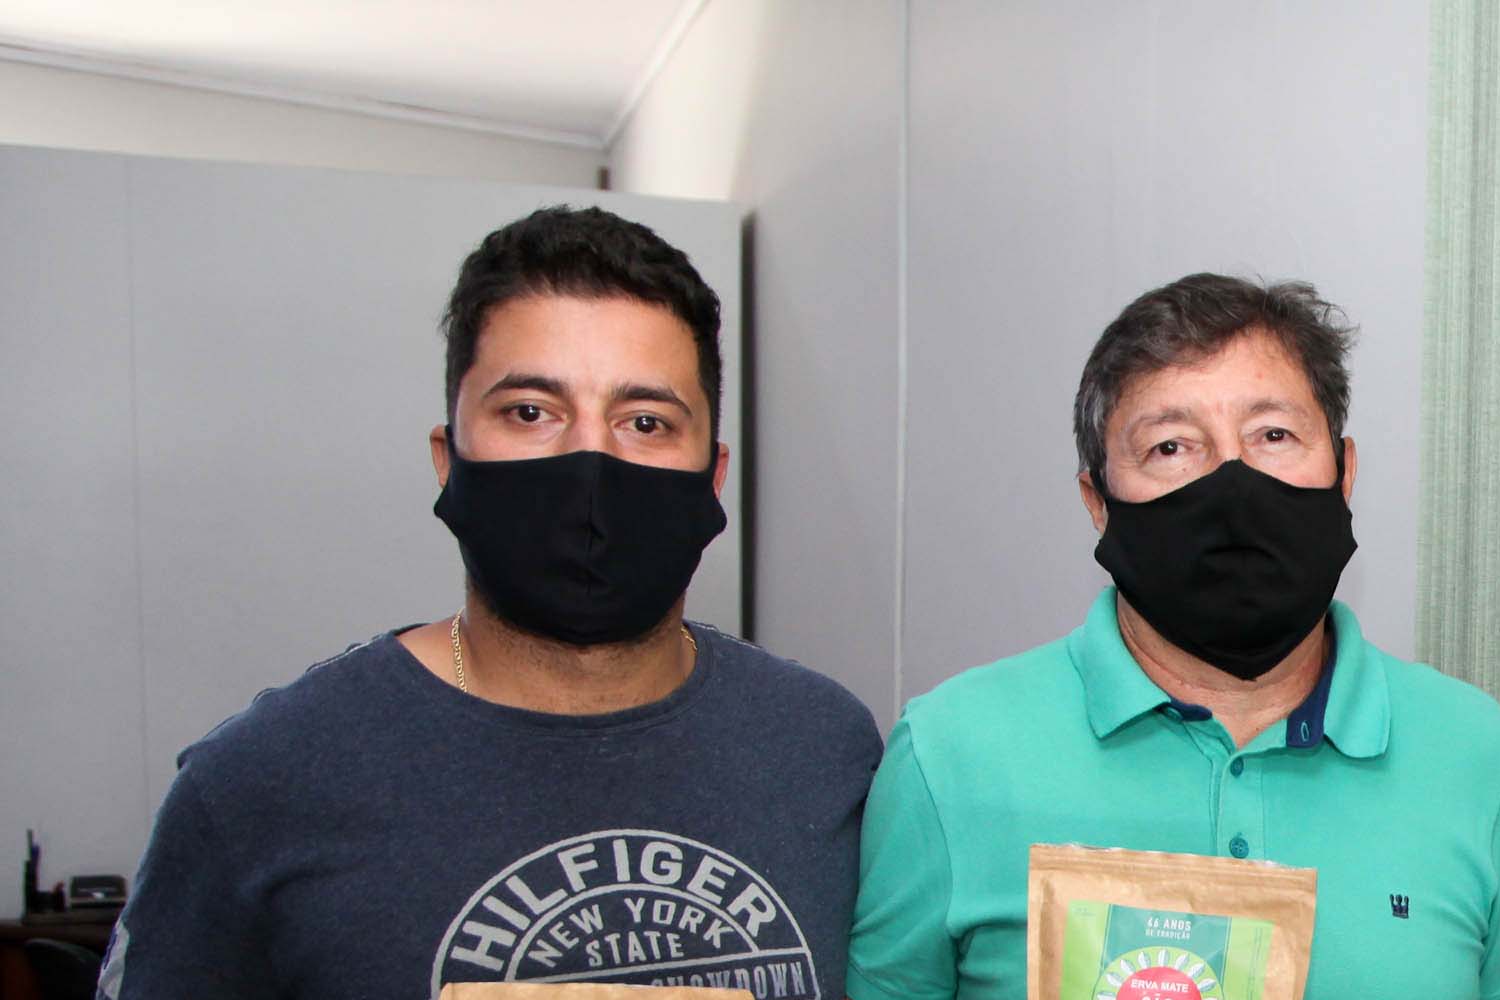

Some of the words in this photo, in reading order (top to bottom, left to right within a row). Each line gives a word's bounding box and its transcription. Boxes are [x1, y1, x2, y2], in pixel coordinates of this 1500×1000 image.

[451, 838, 777, 971] HILFIGER
[528, 903, 606, 969] NEW
[623, 898, 735, 949] YORK
[1163, 918, 1192, 931] ANOS
[587, 930, 685, 967] STATE
[651, 961, 807, 1000] WDOWN
[1130, 978, 1158, 990] ERVA
[1160, 980, 1190, 993] MATE
